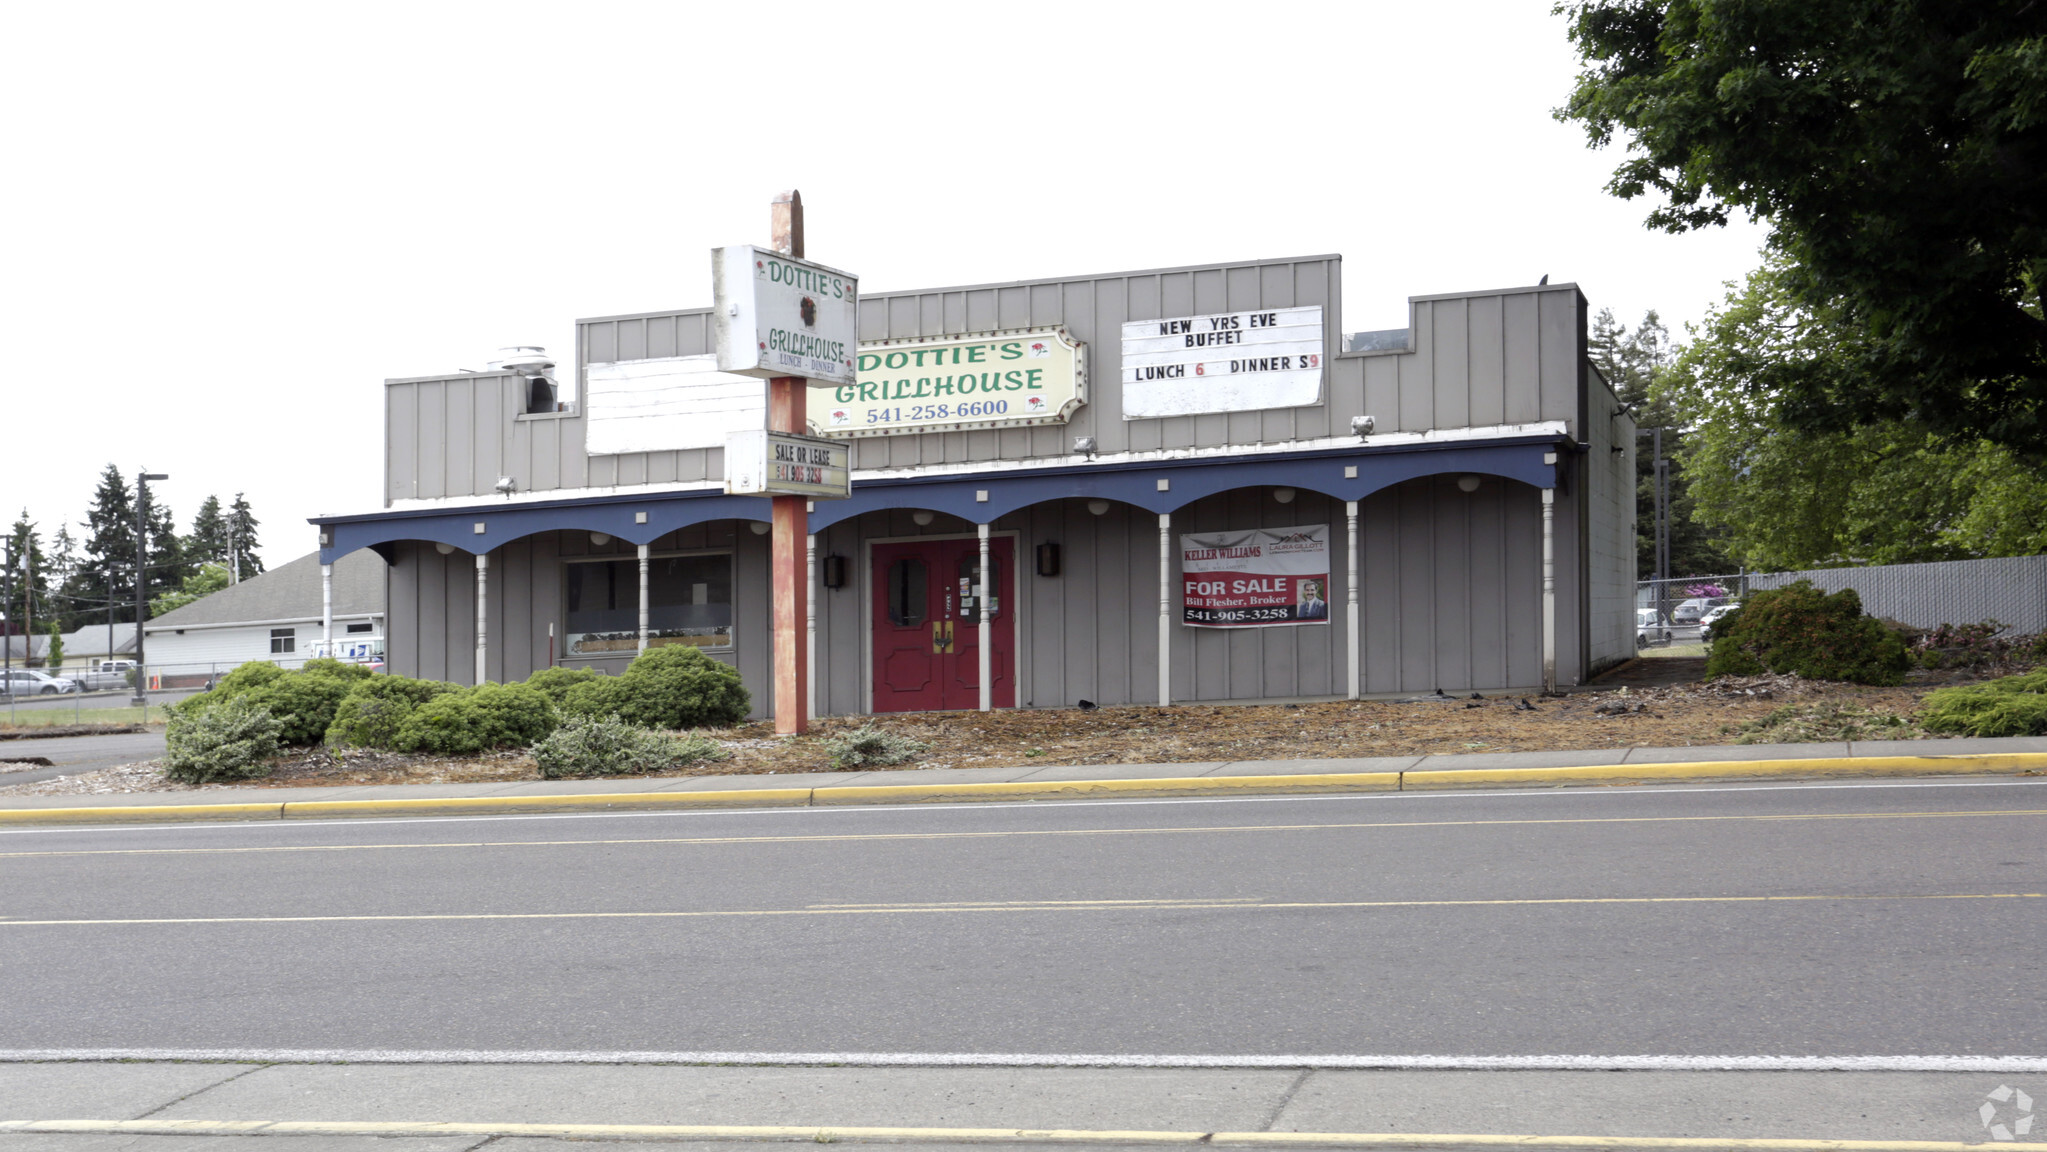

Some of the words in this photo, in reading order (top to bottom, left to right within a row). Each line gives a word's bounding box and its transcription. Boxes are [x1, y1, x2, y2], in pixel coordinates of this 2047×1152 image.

[768, 261, 843, 299] DOTTIE'S
[1160, 320, 1191, 336] NEW
[1210, 316, 1239, 331] YRS
[1250, 313, 1276, 328] EVE
[769, 328, 844, 364] GRILLHOUSE
[1185, 330, 1243, 348] BUFFET
[779, 353, 802, 368] LUNCH
[811, 359, 836, 374] DINNER
[857, 342, 1023, 371] DOTTIE'S
[1136, 364, 1184, 381] LUNCH
[1195, 362, 1204, 376] 6
[1230, 356, 1291, 374] DINNER
[835, 368, 1043, 403] GRILLHOUSE
[867, 399, 1008, 424] 541-258-6600
[775, 444, 794, 462] SALE
[797, 446, 807, 463] OR
[809, 448, 830, 466] LEASE
[776, 464, 789, 481] 541
[791, 465, 804, 482] 905
[1184, 548, 1217, 561] KELLER
[1218, 546, 1262, 560] WILLIAMS
[1269, 543, 1293, 551] LAURA
[1185, 580, 1226, 596] FOR
[1232, 578, 1287, 594] SALE
[1186, 597, 1203, 606] Bill
[1206, 597, 1247, 607] Flesher,
[1250, 595, 1287, 605] Broker
[1186, 608, 1288, 621] 541-905-3258
